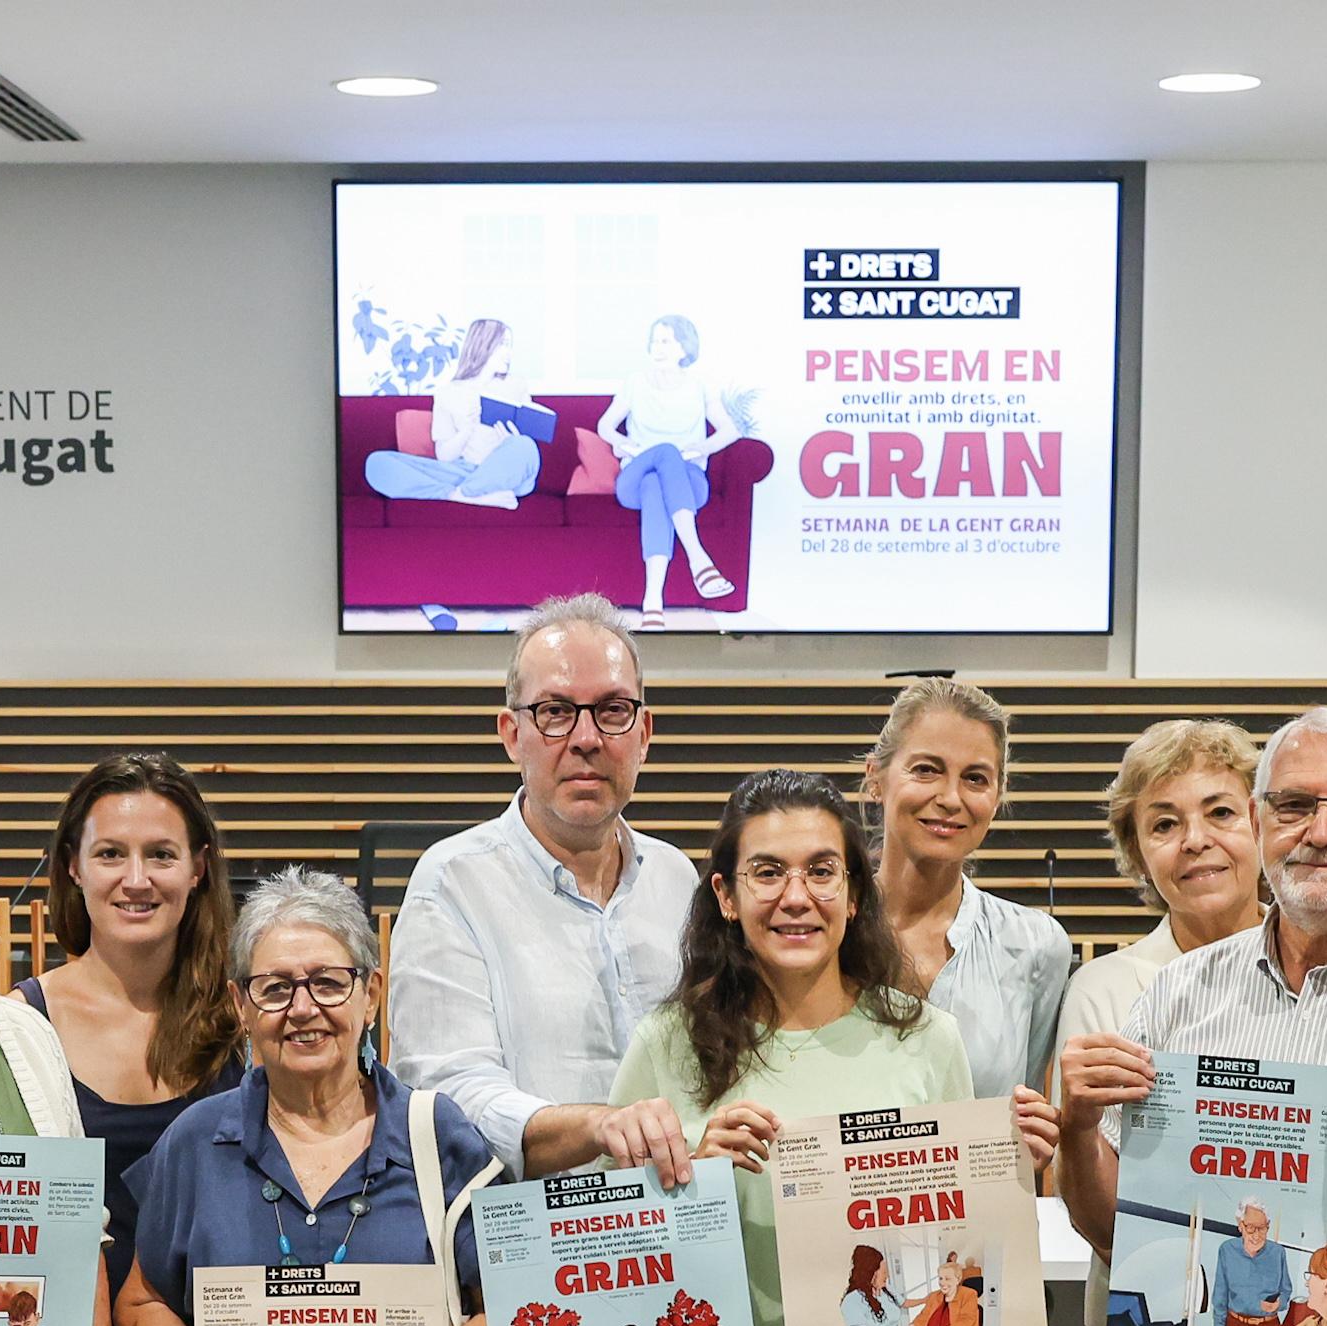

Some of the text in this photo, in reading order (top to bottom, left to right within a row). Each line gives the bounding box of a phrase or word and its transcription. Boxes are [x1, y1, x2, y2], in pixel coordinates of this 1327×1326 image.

[840, 253, 933, 278] DRETS
[839, 291, 916, 316] SANT
[919, 291, 1014, 316] CUGAT
[805, 349, 1061, 382] PENSEM EN
[68, 390, 114, 421] DE
[842, 391, 1026, 407] envellir amb drets, en
[825, 410, 911, 424] comunitat
[927, 410, 964, 424] amb
[969, 410, 1042, 427] dignitat.
[799, 430, 1063, 499] GRAN
[802, 518, 1062, 532] SETMANA DE LA GENT GRAN
[802, 539, 1062, 553] Del 28 de setembre al 3 d'octubre
[1214, 1060, 1256, 1072] DRETS
[1213, 1076, 1247, 1089] SANT
[1249, 1080, 1291, 1092] CUGAT
[856, 1111, 897, 1124] DRETS
[1195, 1099, 1279, 1121] PENSEM
[1284, 1107, 1311, 1124] EN
[857, 1128, 891, 1139] SANT
[892, 1123, 934, 1136] CUGAT
[1198, 1120, 1226, 1129] persones
[1198, 1128, 1231, 1136] autonomia
[1199, 1136, 1229, 1145] transport
[844, 1150, 926, 1172] PENSEM
[932, 1146, 958, 1163] EN
[1190, 1144, 1309, 1183] GRAN
[17, 1180, 41, 1196] EN
[560, 1175, 603, 1189] DRETS
[562, 1192, 597, 1205] SANT
[598, 1186, 640, 1200] CUGAT
[482, 1203, 513, 1212] Setmana
[509, 1209, 526, 1217] Gran
[847, 1190, 965, 1230] GRAN
[550, 1213, 634, 1237] PENSEM
[639, 1209, 665, 1226] EN
[281, 1268, 322, 1279] DRETS
[555, 1253, 674, 1295] GRAN
[281, 1284, 314, 1295] SANT
[316, 1283, 357, 1294] CUGAT
[267, 1308, 348, 1325] PENSEM
[353, 1308, 377, 1324] EN
